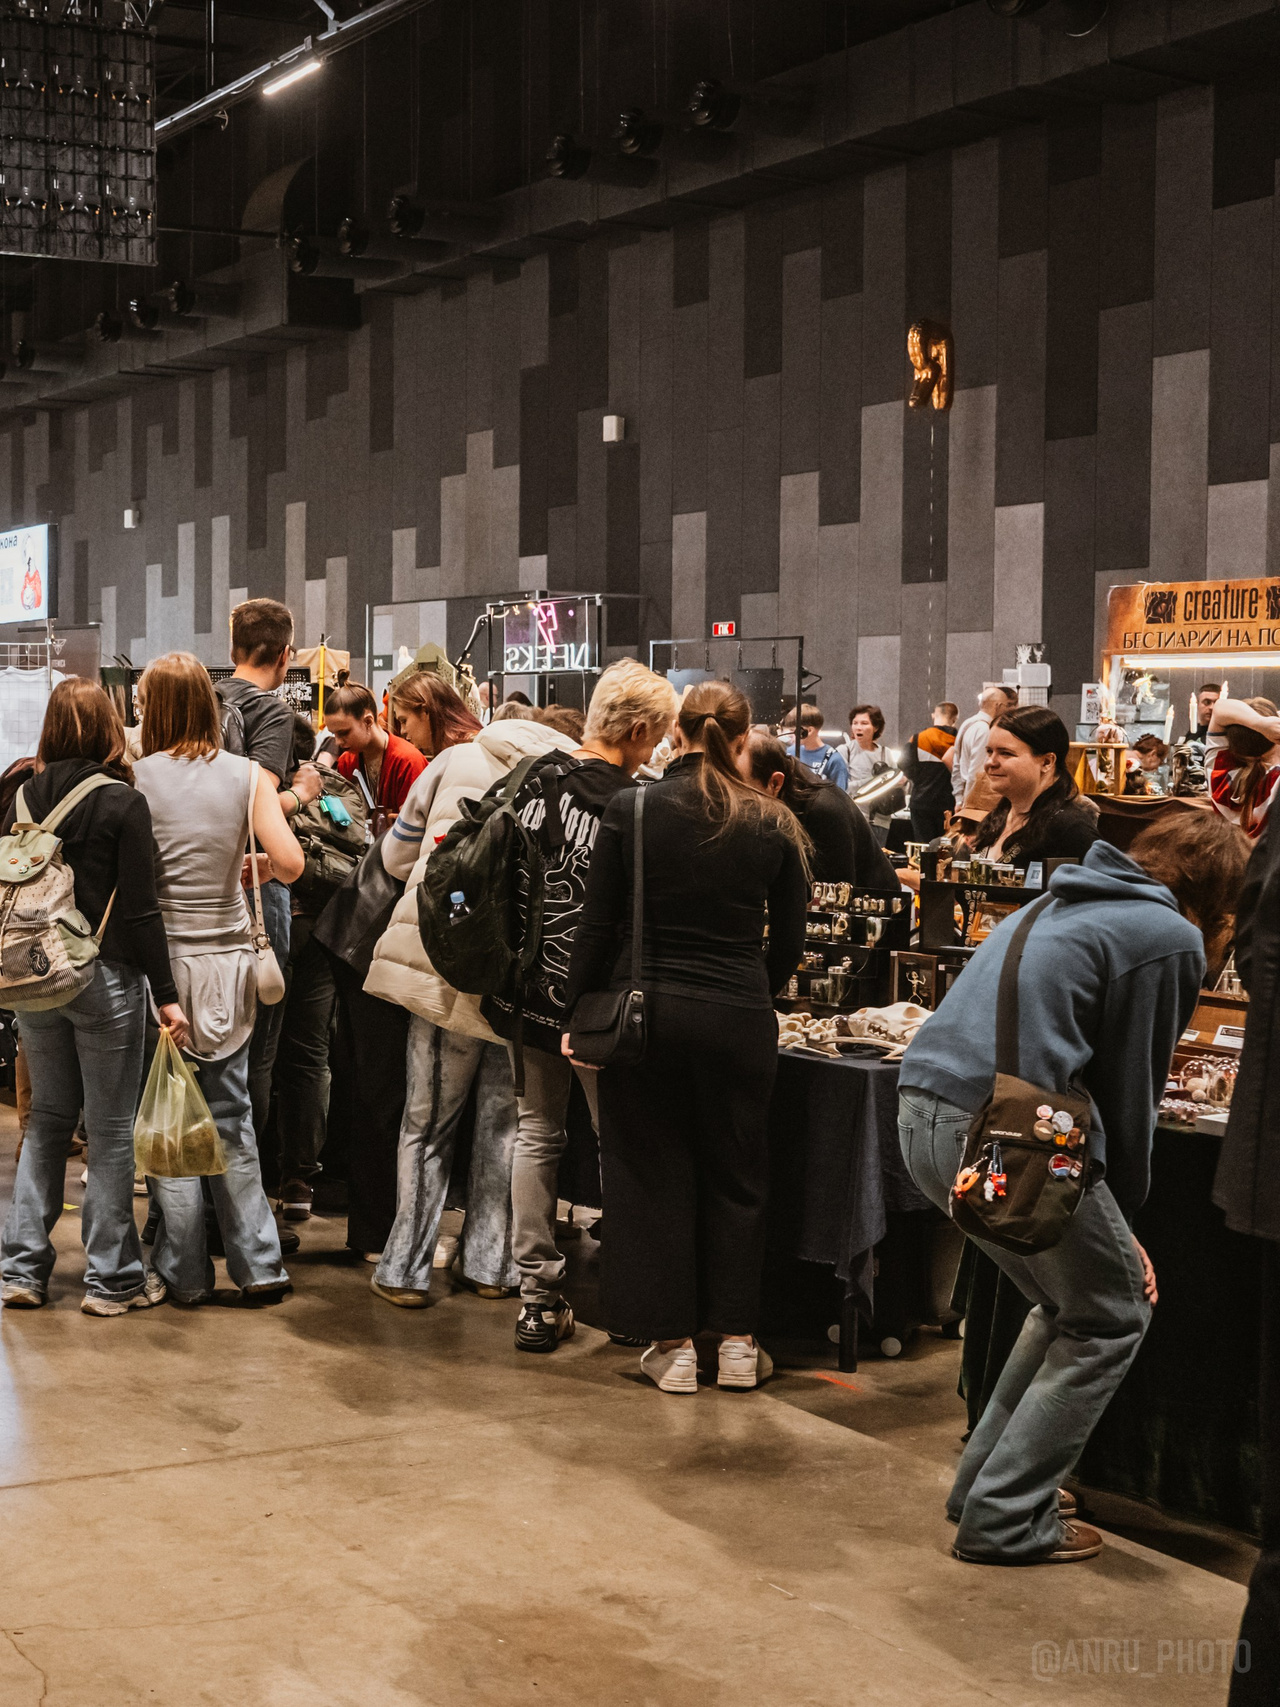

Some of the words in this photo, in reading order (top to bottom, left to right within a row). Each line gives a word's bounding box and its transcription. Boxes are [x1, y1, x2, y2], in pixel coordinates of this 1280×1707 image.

[1183, 584, 1259, 622] creature
[1123, 628, 1223, 649] БЕСТИАРИЙ
[1227, 629, 1252, 647] НА
